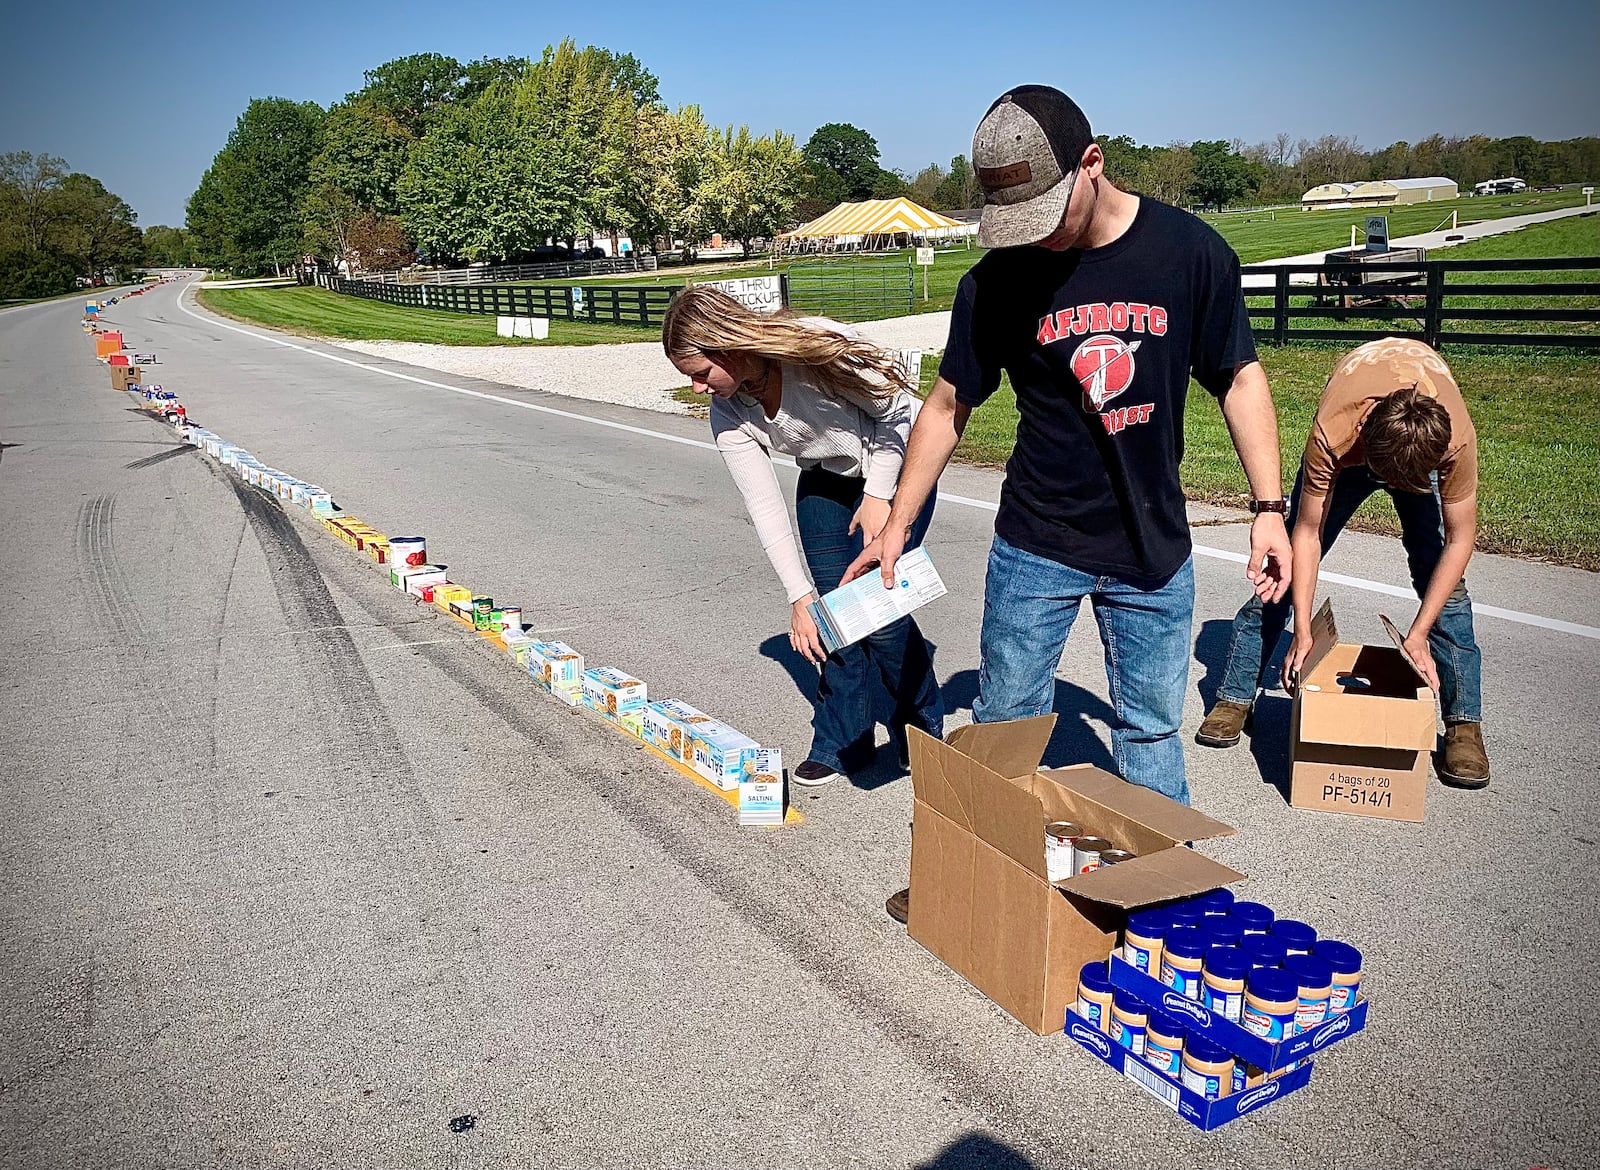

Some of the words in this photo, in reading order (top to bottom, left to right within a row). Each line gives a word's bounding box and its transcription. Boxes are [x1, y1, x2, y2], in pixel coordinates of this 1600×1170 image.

[984, 168, 1025, 182] RIAT
[739, 278, 772, 292] THRU
[1037, 302, 1168, 345] AFJROTC
[581, 684, 605, 705] SALTINE
[622, 695, 641, 703] SALTINE
[642, 716, 668, 740] SALTINE
[695, 749, 724, 777] SALTINE
[755, 749, 769, 773] SALTINE
[1329, 772, 1335, 782] 4
[1338, 773, 1363, 787] bags
[1365, 777, 1376, 787] of
[1377, 777, 1390, 788] 20
[1322, 785, 1392, 808] PF-514/1
